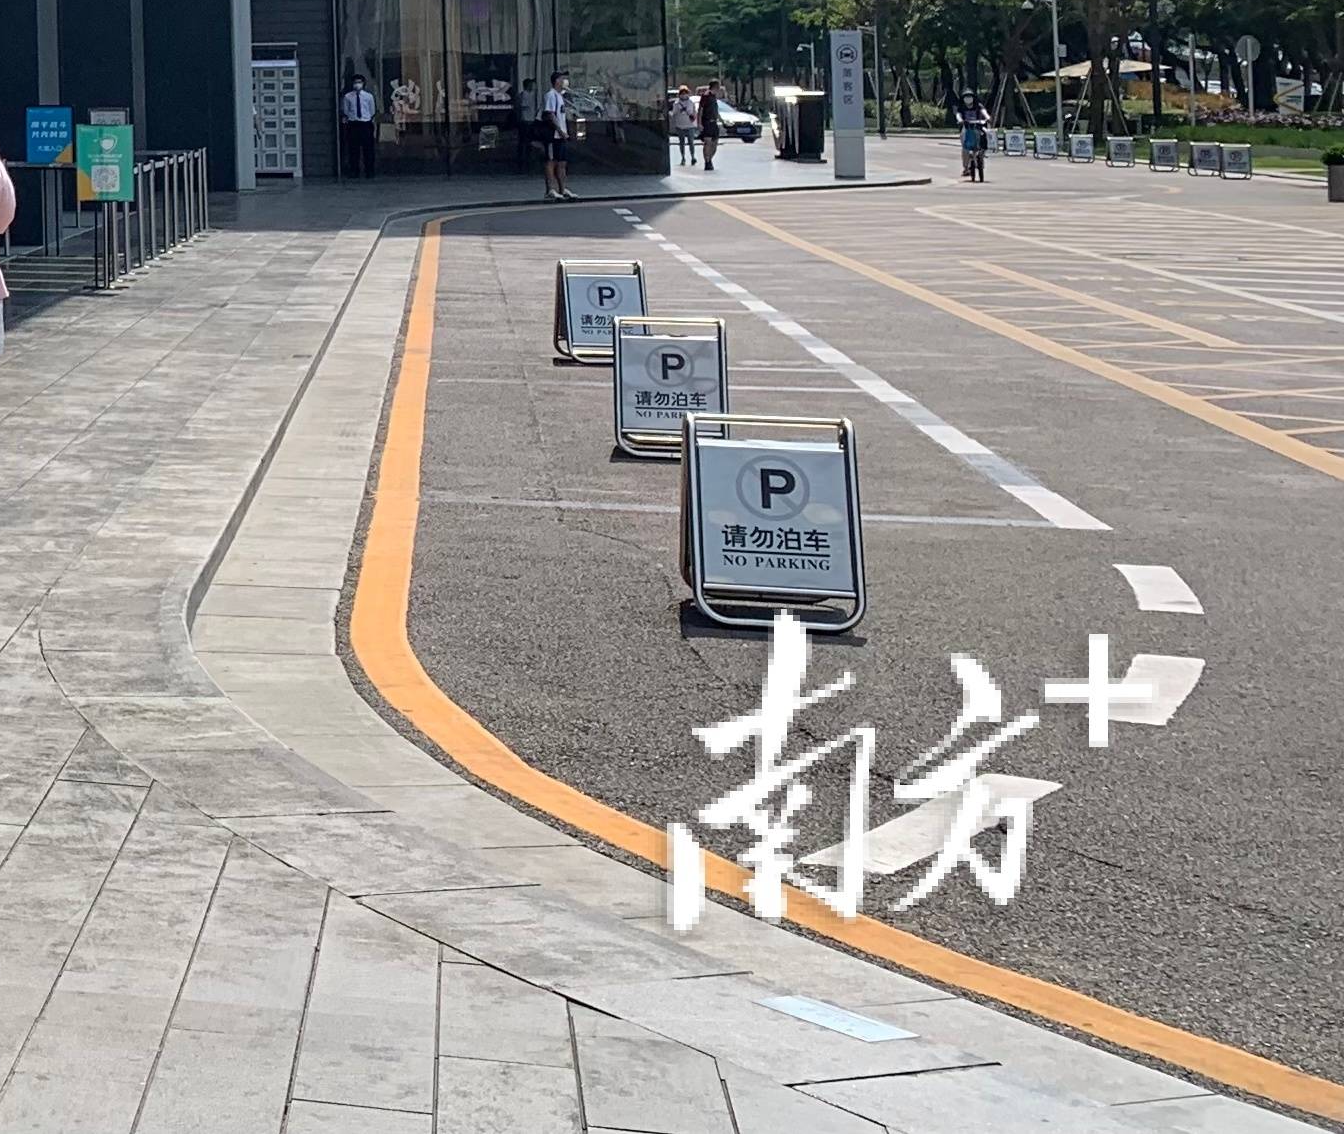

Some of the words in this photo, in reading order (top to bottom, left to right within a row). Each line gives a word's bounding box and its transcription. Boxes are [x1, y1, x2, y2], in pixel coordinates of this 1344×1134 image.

[598, 286, 615, 307] P
[661, 353, 685, 380] P
[635, 390, 708, 407] 请勿泊车
[760, 468, 796, 509] P
[721, 524, 831, 552] 请勿泊车
[723, 554, 747, 567] NO
[755, 556, 831, 571] PARKING
